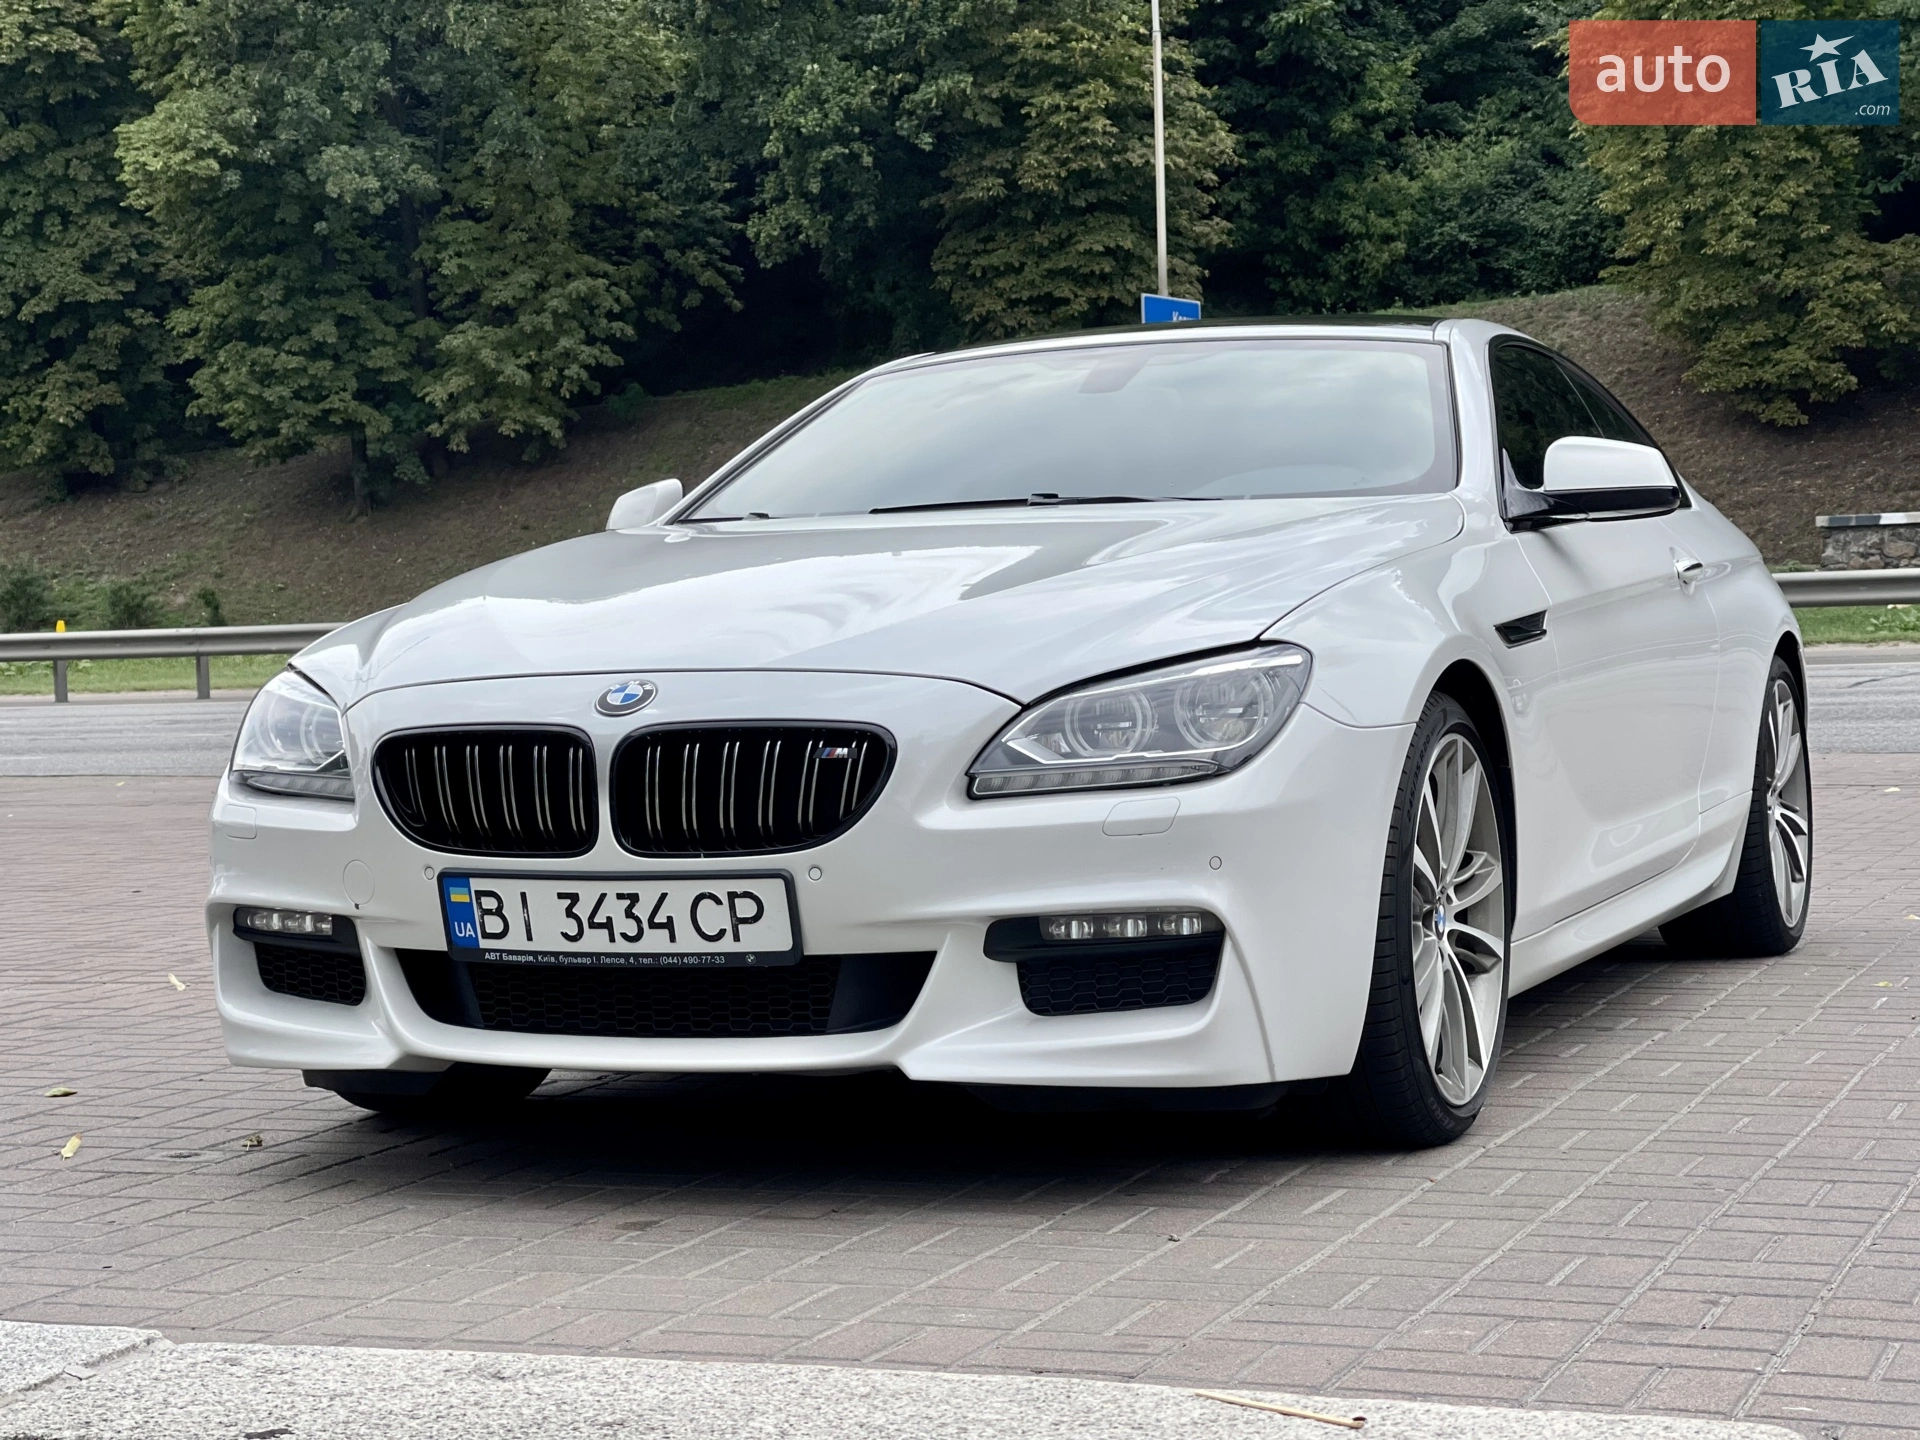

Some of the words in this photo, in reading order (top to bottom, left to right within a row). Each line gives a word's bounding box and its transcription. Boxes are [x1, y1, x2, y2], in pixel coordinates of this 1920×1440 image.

[473, 889, 534, 942] BI
[556, 891, 677, 943] 3434
[689, 890, 765, 943] CP
[454, 921, 476, 938] UA
[502, 952, 536, 963] Баварія,
[537, 954, 558, 963] Київ,
[558, 955, 592, 964] бульвар
[600, 955, 628, 965] Лепсе,
[629, 956, 637, 965] 4,
[659, 955, 682, 966] (044)
[682, 955, 725, 965] 490-77-33
